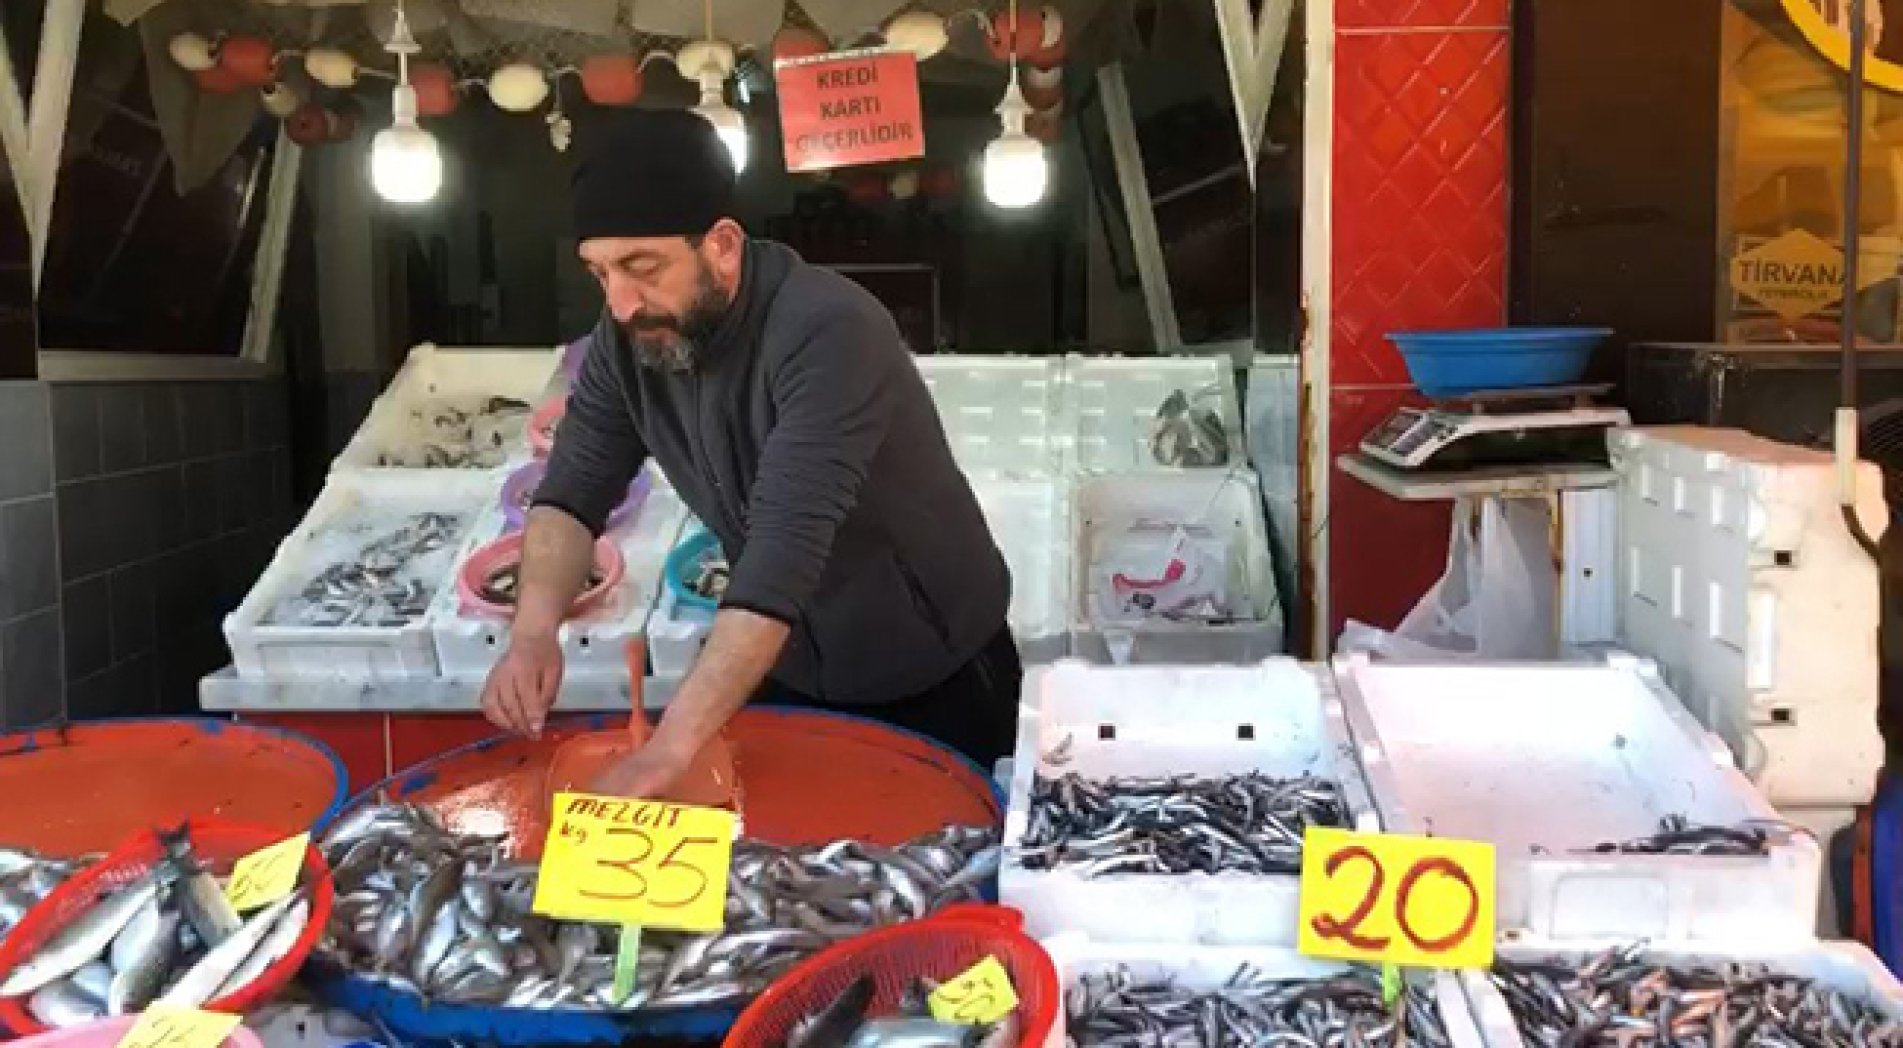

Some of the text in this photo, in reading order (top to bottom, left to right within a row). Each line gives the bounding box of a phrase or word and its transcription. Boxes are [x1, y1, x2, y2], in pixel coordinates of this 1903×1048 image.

[816, 61, 879, 90] KREDİ
[819, 95, 882, 121] KARTI
[578, 827, 718, 909] 35
[1310, 845, 1480, 954] 20
